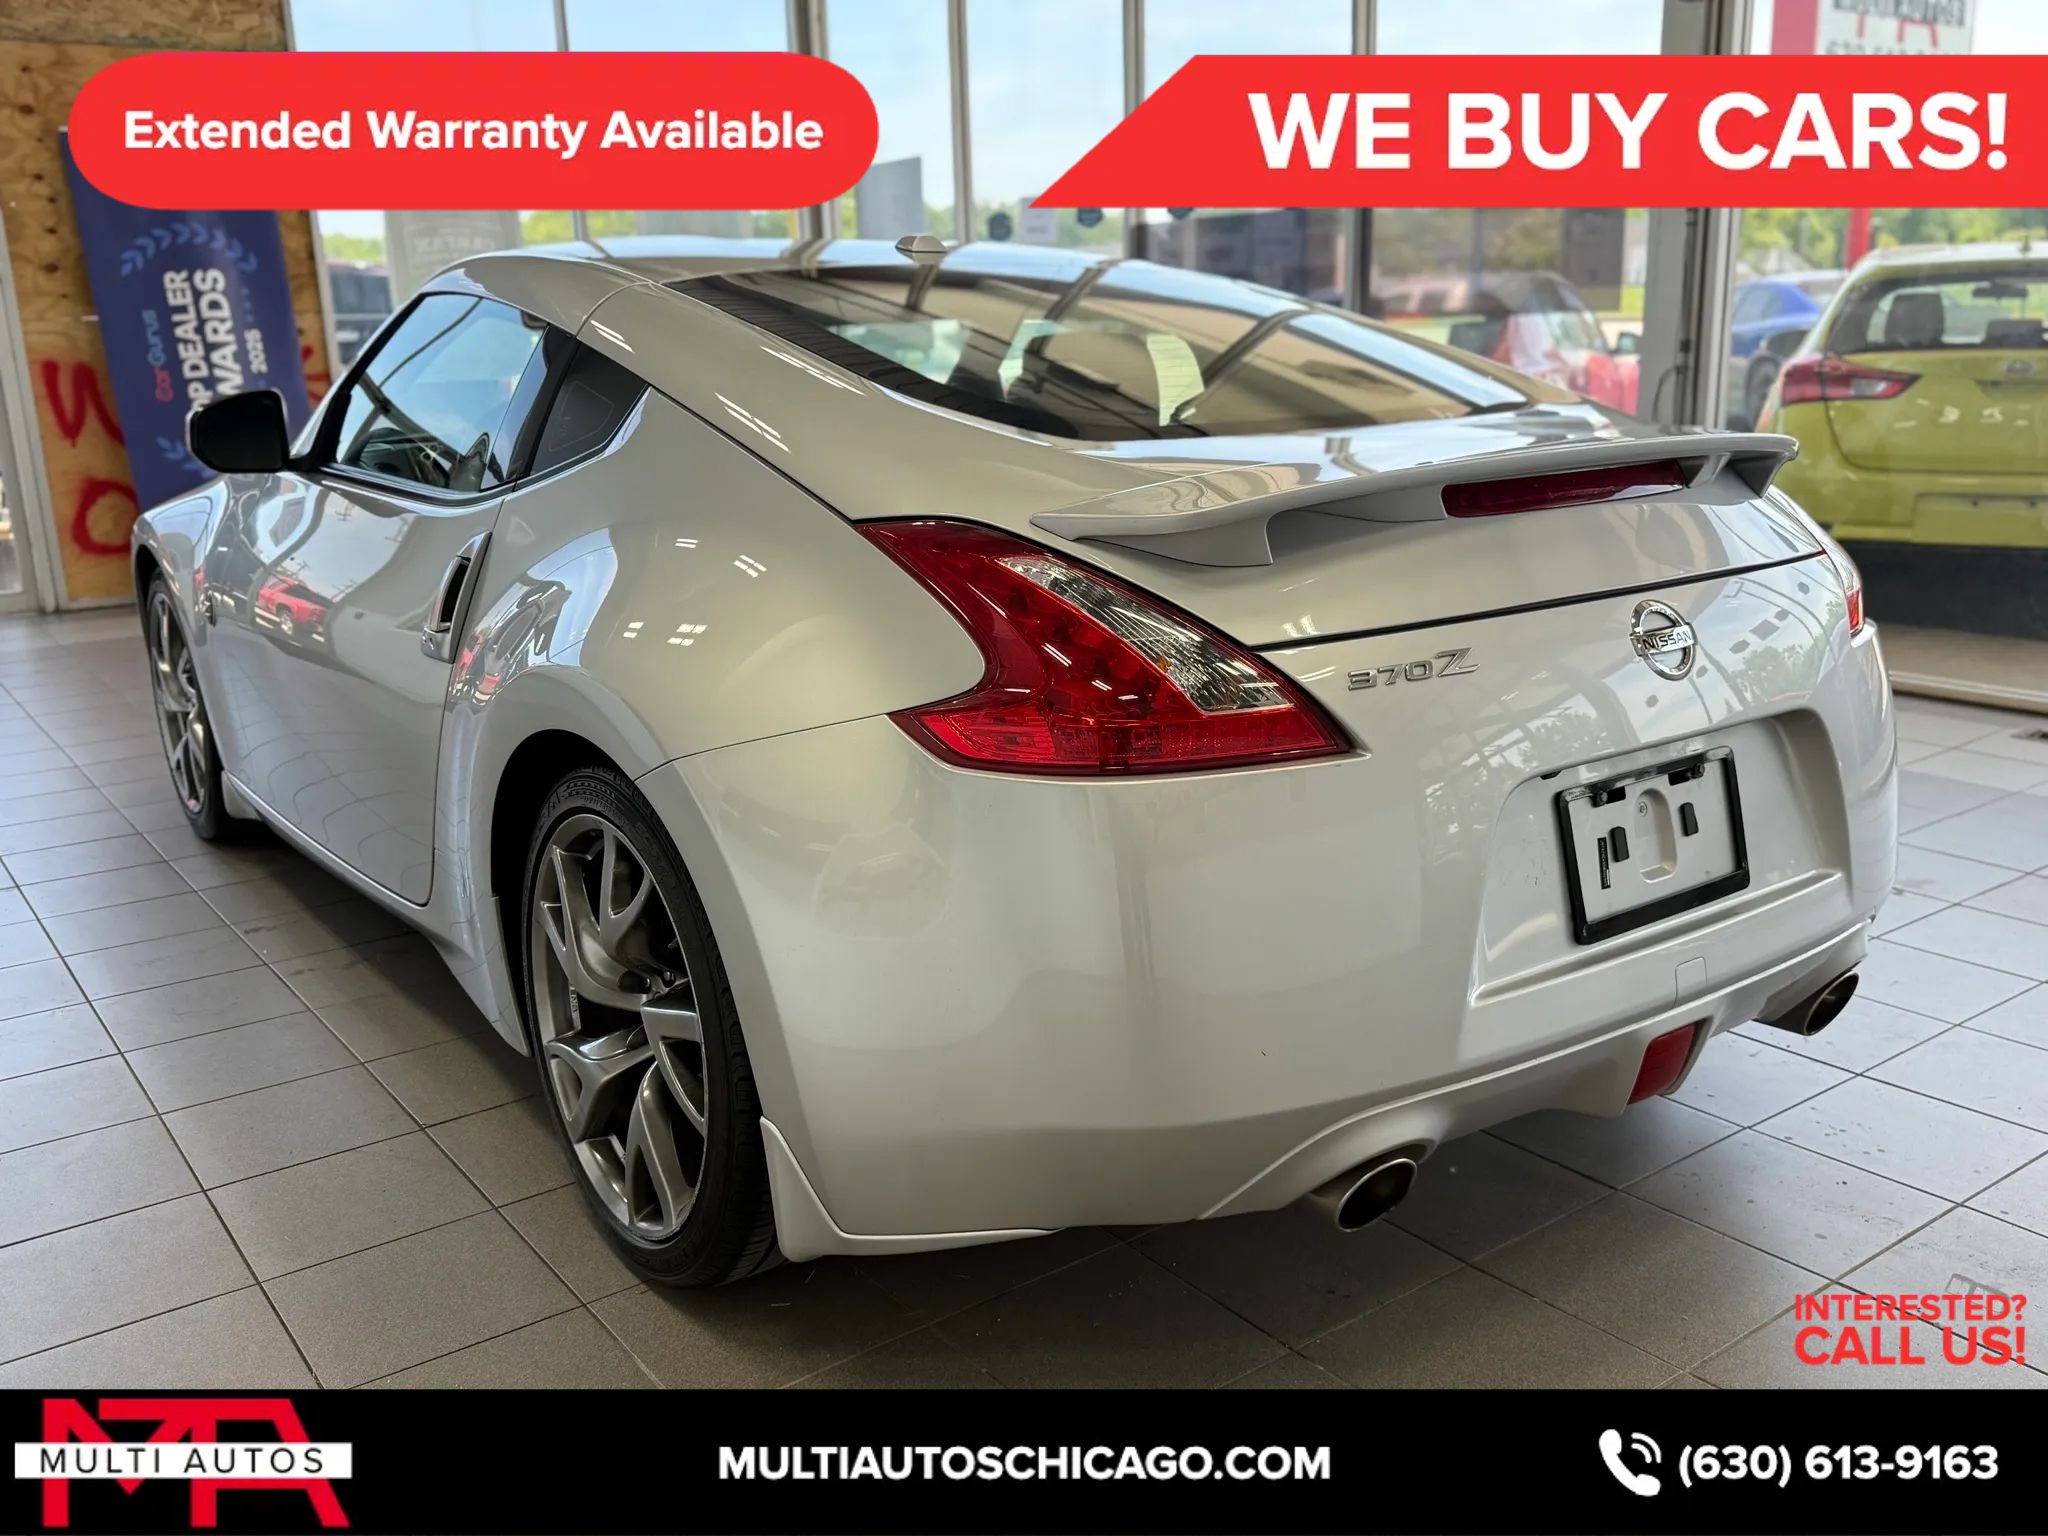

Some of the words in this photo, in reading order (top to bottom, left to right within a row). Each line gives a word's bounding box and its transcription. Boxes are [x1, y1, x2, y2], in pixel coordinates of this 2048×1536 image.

[142, 309, 174, 402] CarGurus
[163, 269, 210, 379] DEALER
[193, 267, 244, 397] WARDS
[244, 328, 268, 375] 2025
[1347, 646, 1481, 692] 370Z
[1642, 630, 1692, 650] NISSAN
